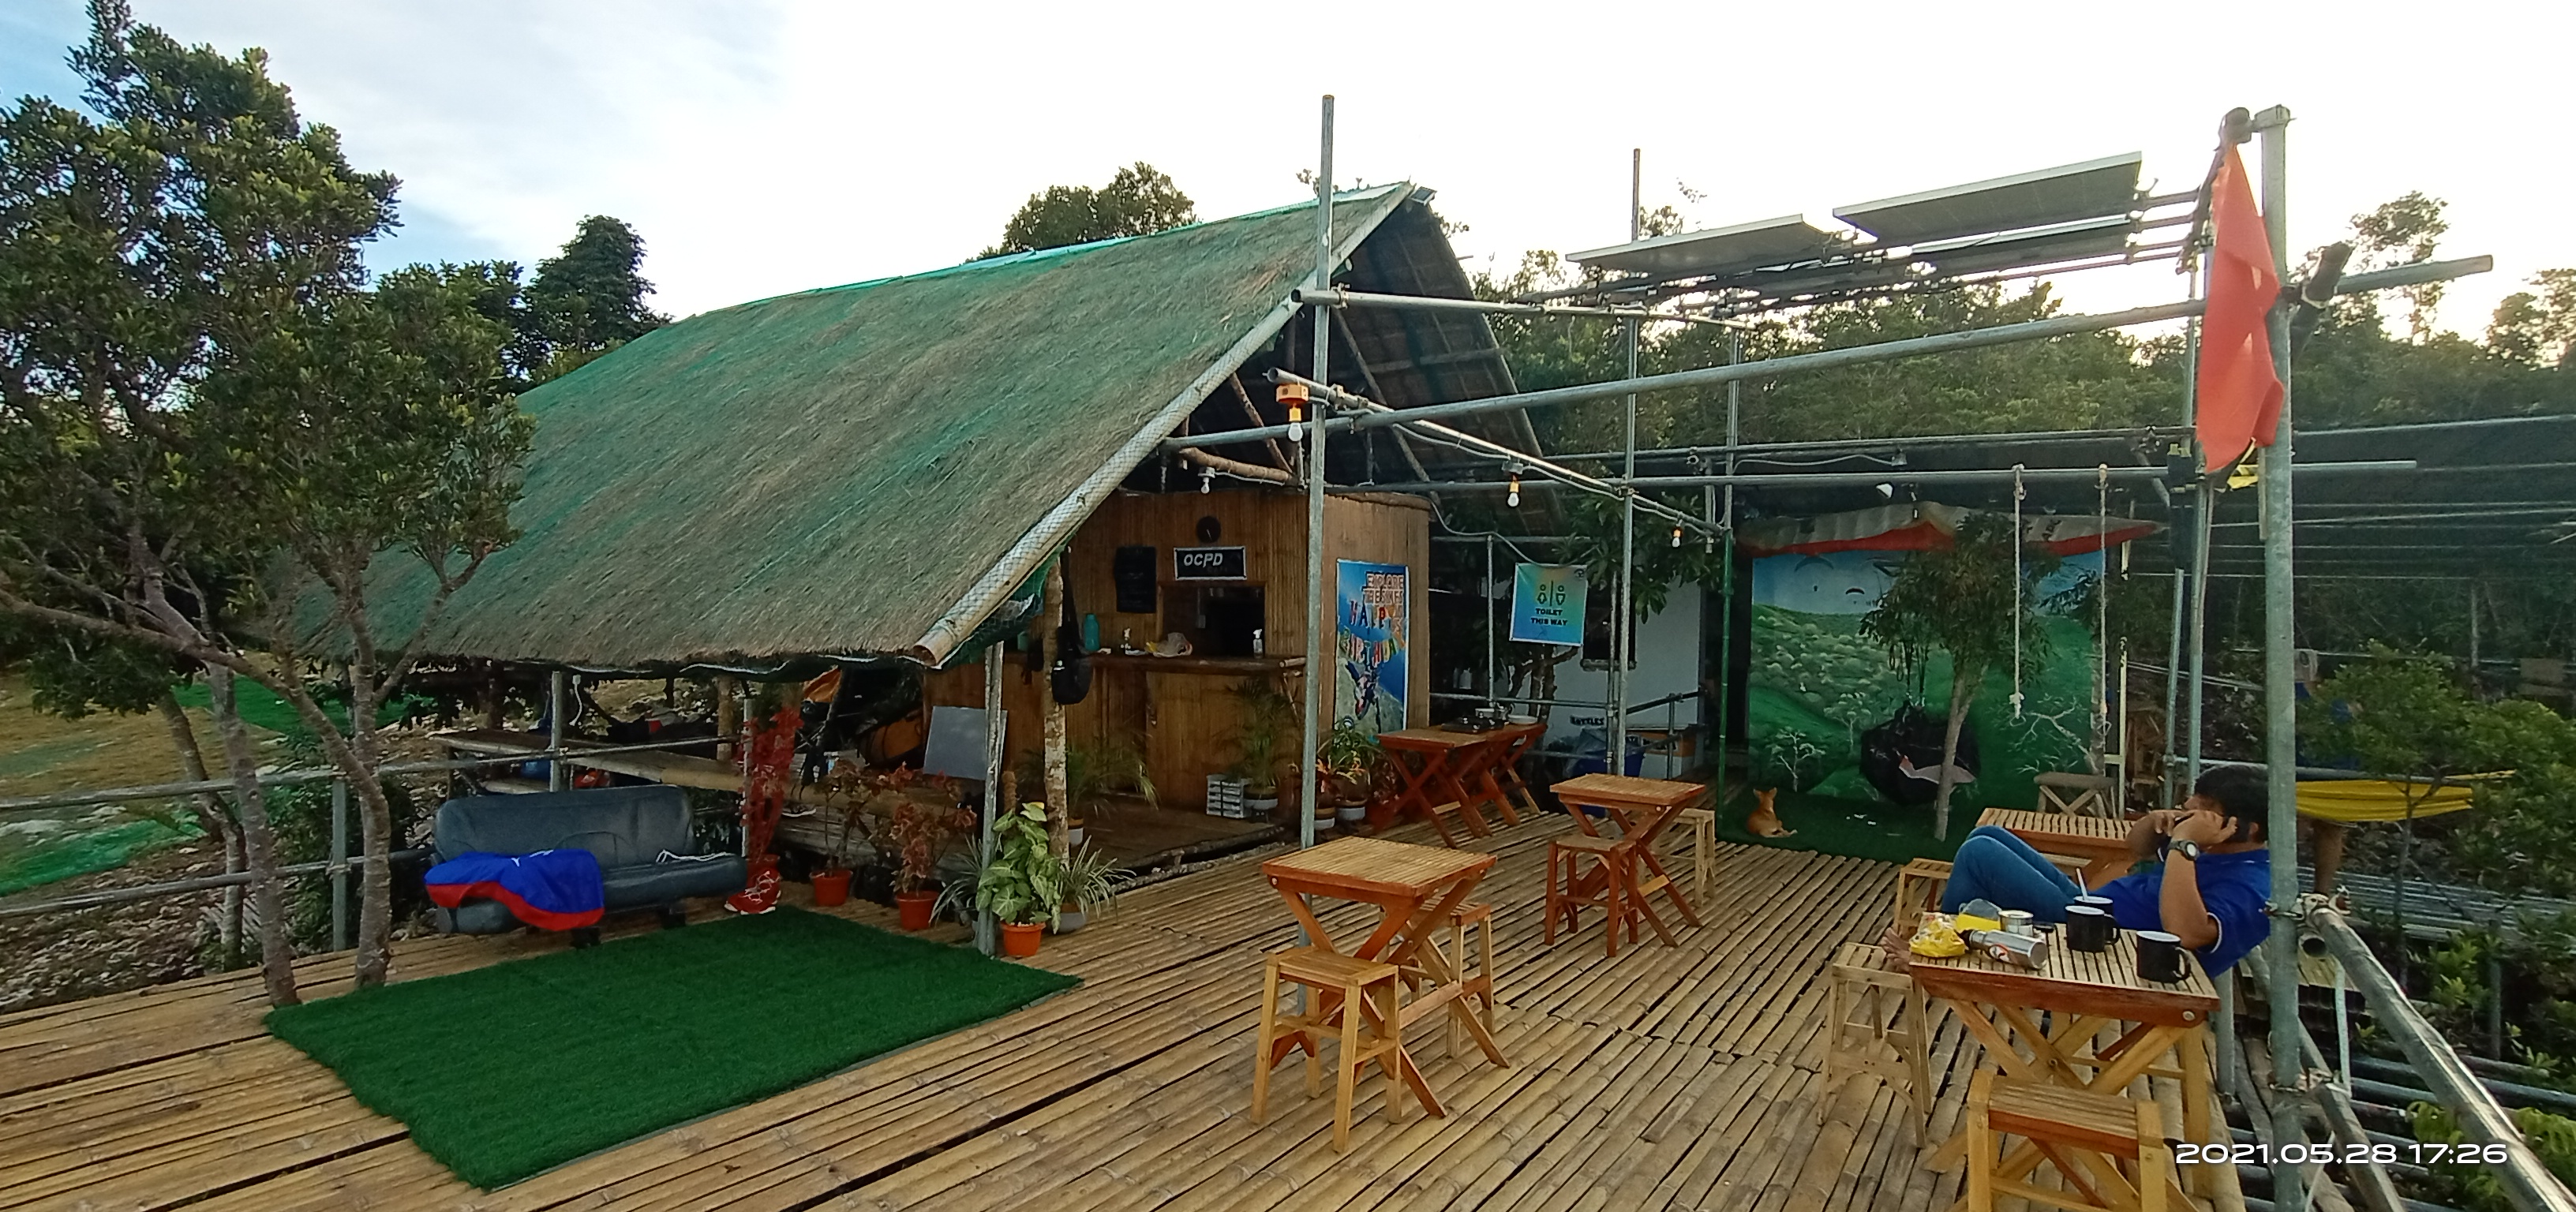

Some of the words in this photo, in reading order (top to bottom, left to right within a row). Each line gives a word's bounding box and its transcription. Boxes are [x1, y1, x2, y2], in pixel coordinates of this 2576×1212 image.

[1184, 552, 1223, 568] OCPD
[1367, 574, 1404, 589] EXPLORE
[1535, 608, 1563, 616] TOILET
